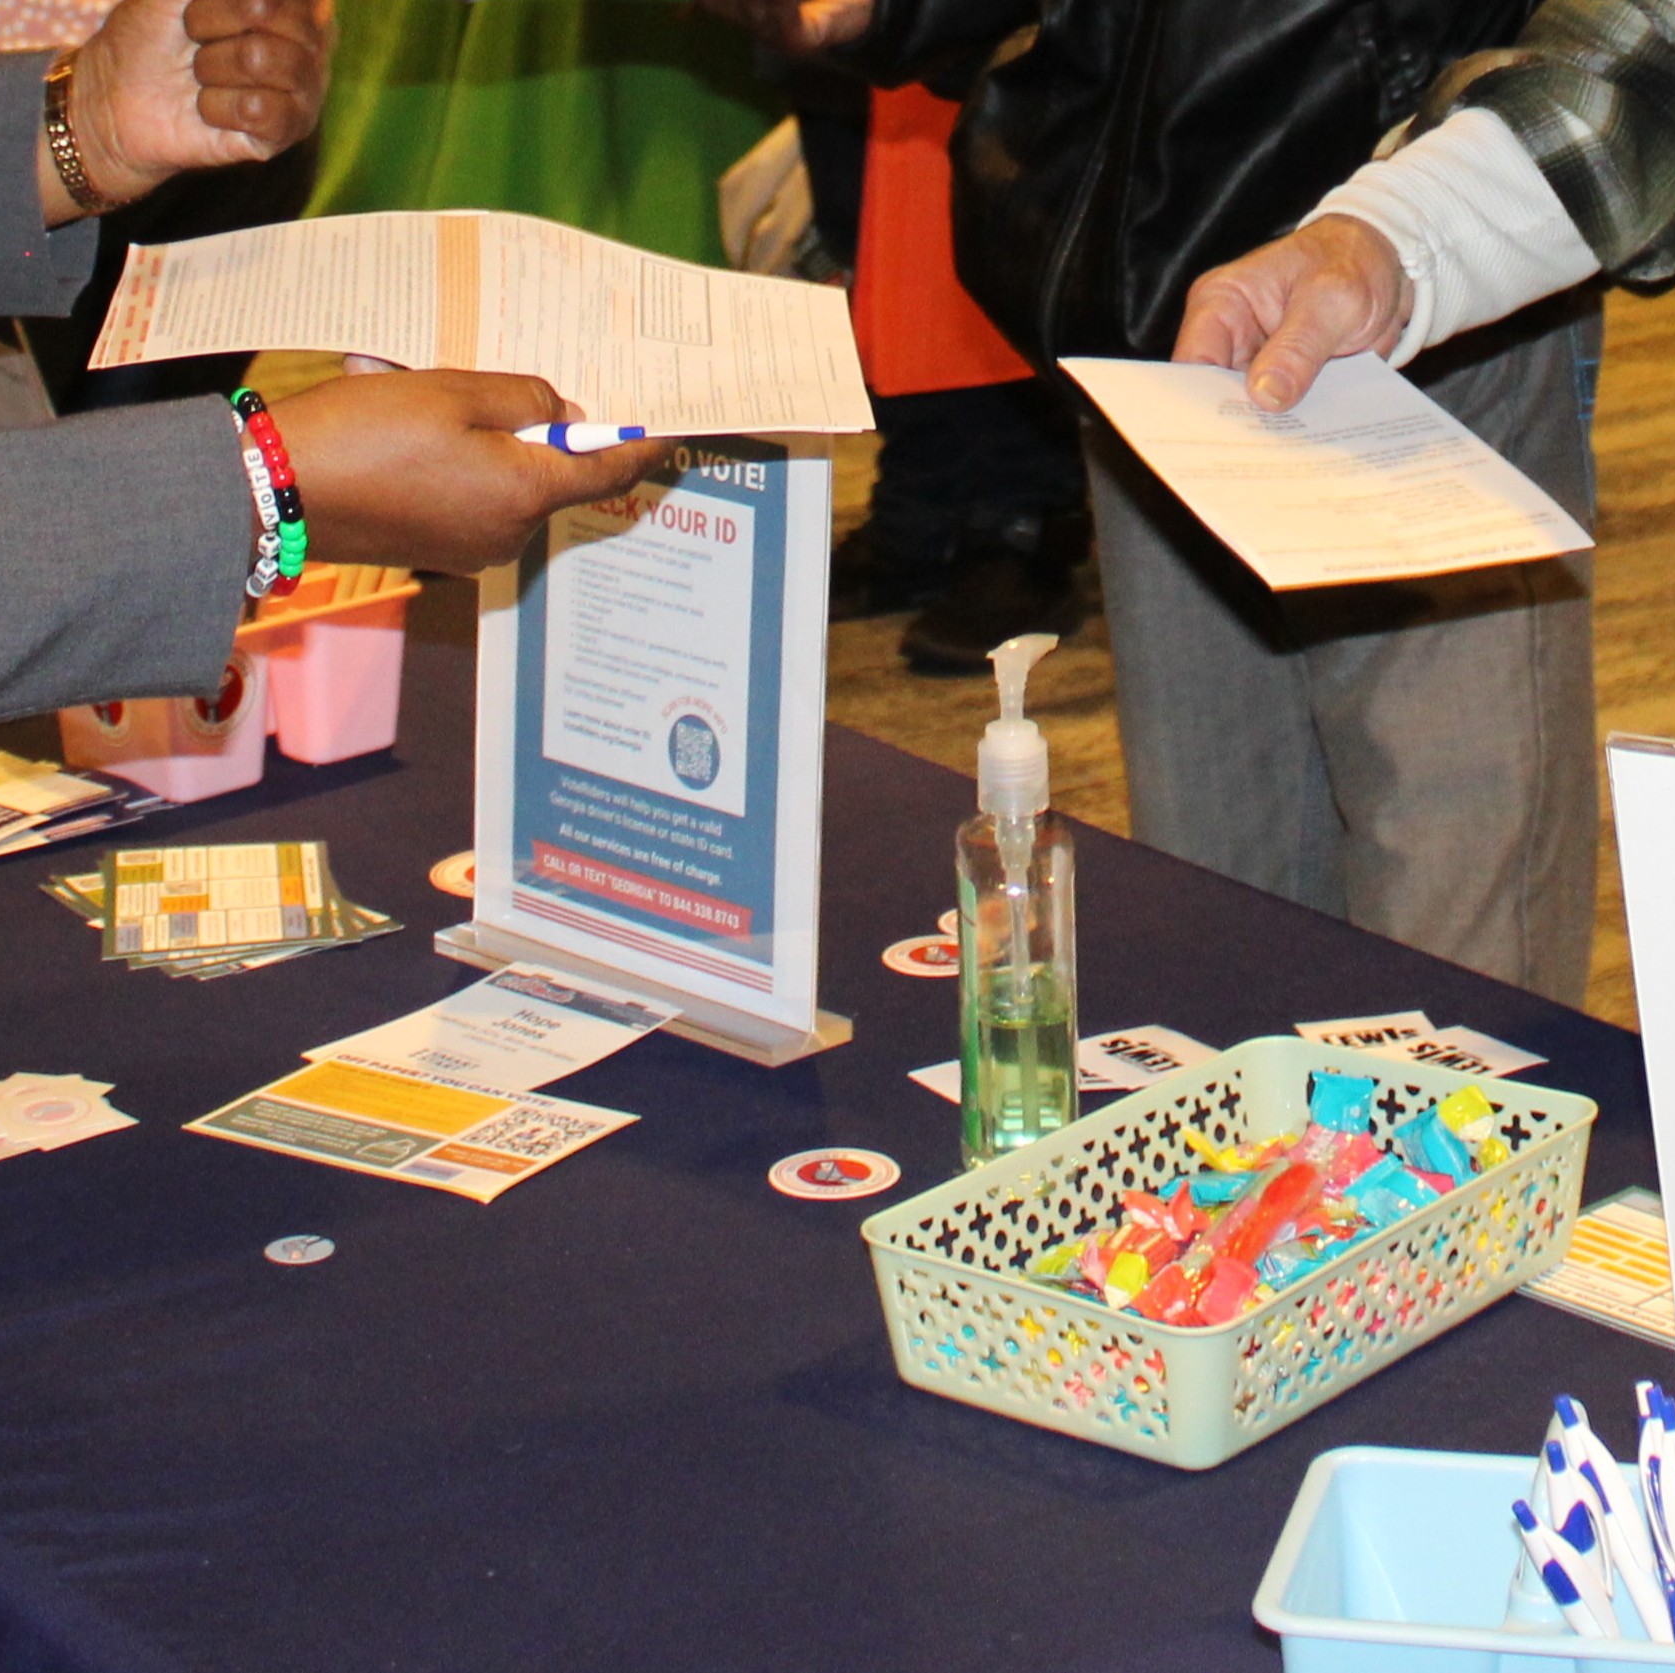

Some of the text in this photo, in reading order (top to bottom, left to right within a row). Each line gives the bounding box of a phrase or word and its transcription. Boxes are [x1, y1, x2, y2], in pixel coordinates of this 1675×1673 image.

[697, 449, 766, 492] VOTE!
[646, 498, 707, 539] YOUR
[715, 515, 737, 545] ID
[650, 850, 671, 871] free
[672, 859, 685, 875] of
[543, 853, 565, 874] CALL
[567, 861, 582, 879] OR
[584, 866, 606, 886] TEXT
[659, 891, 671, 907] TO
[513, 1008, 562, 1030] Hope
[430, 1074, 467, 1089] YOU
[466, 1082, 505, 1097] CAN
